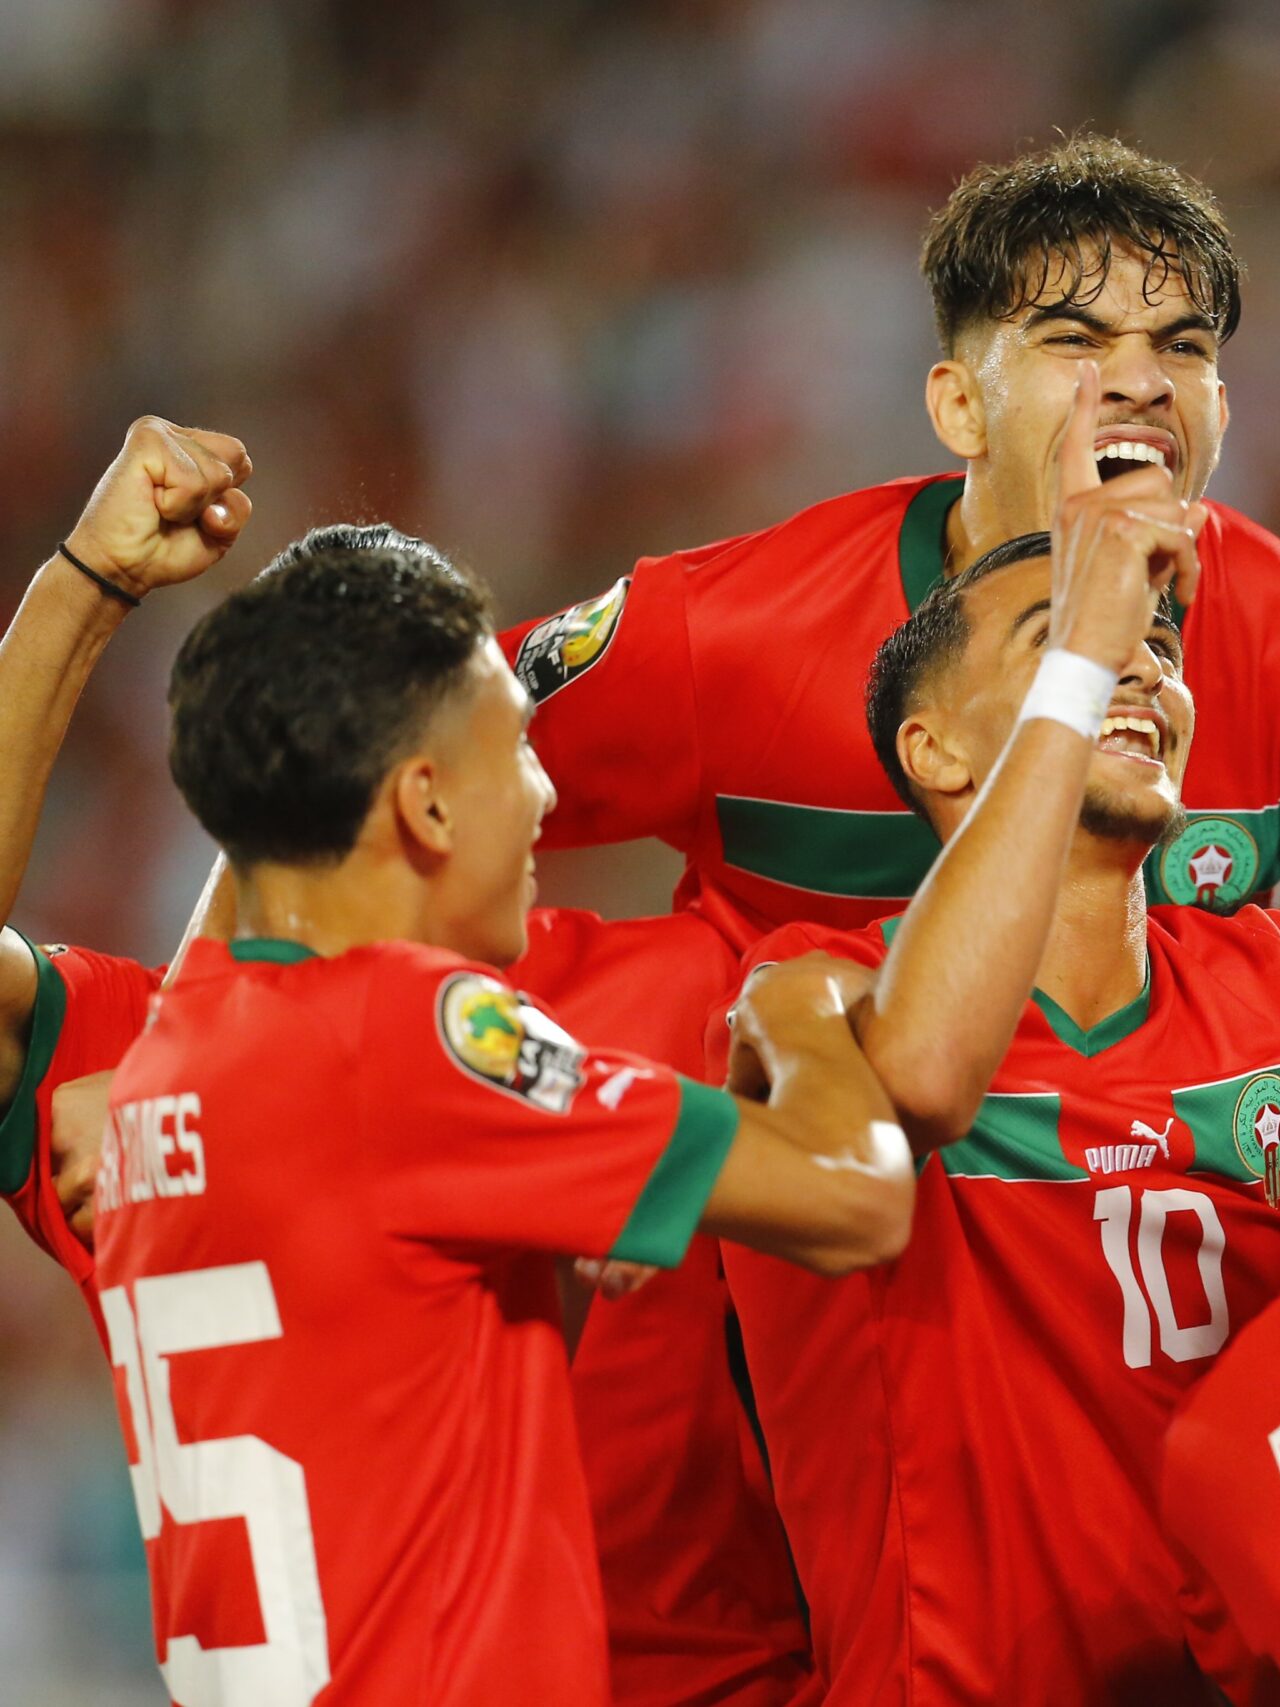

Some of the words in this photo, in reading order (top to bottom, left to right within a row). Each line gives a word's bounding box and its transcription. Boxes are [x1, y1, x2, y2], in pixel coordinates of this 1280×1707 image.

[1084, 1144, 1157, 1175] PUMA
[1093, 1185, 1230, 1369] 10
[100, 1260, 332, 1707] 15
